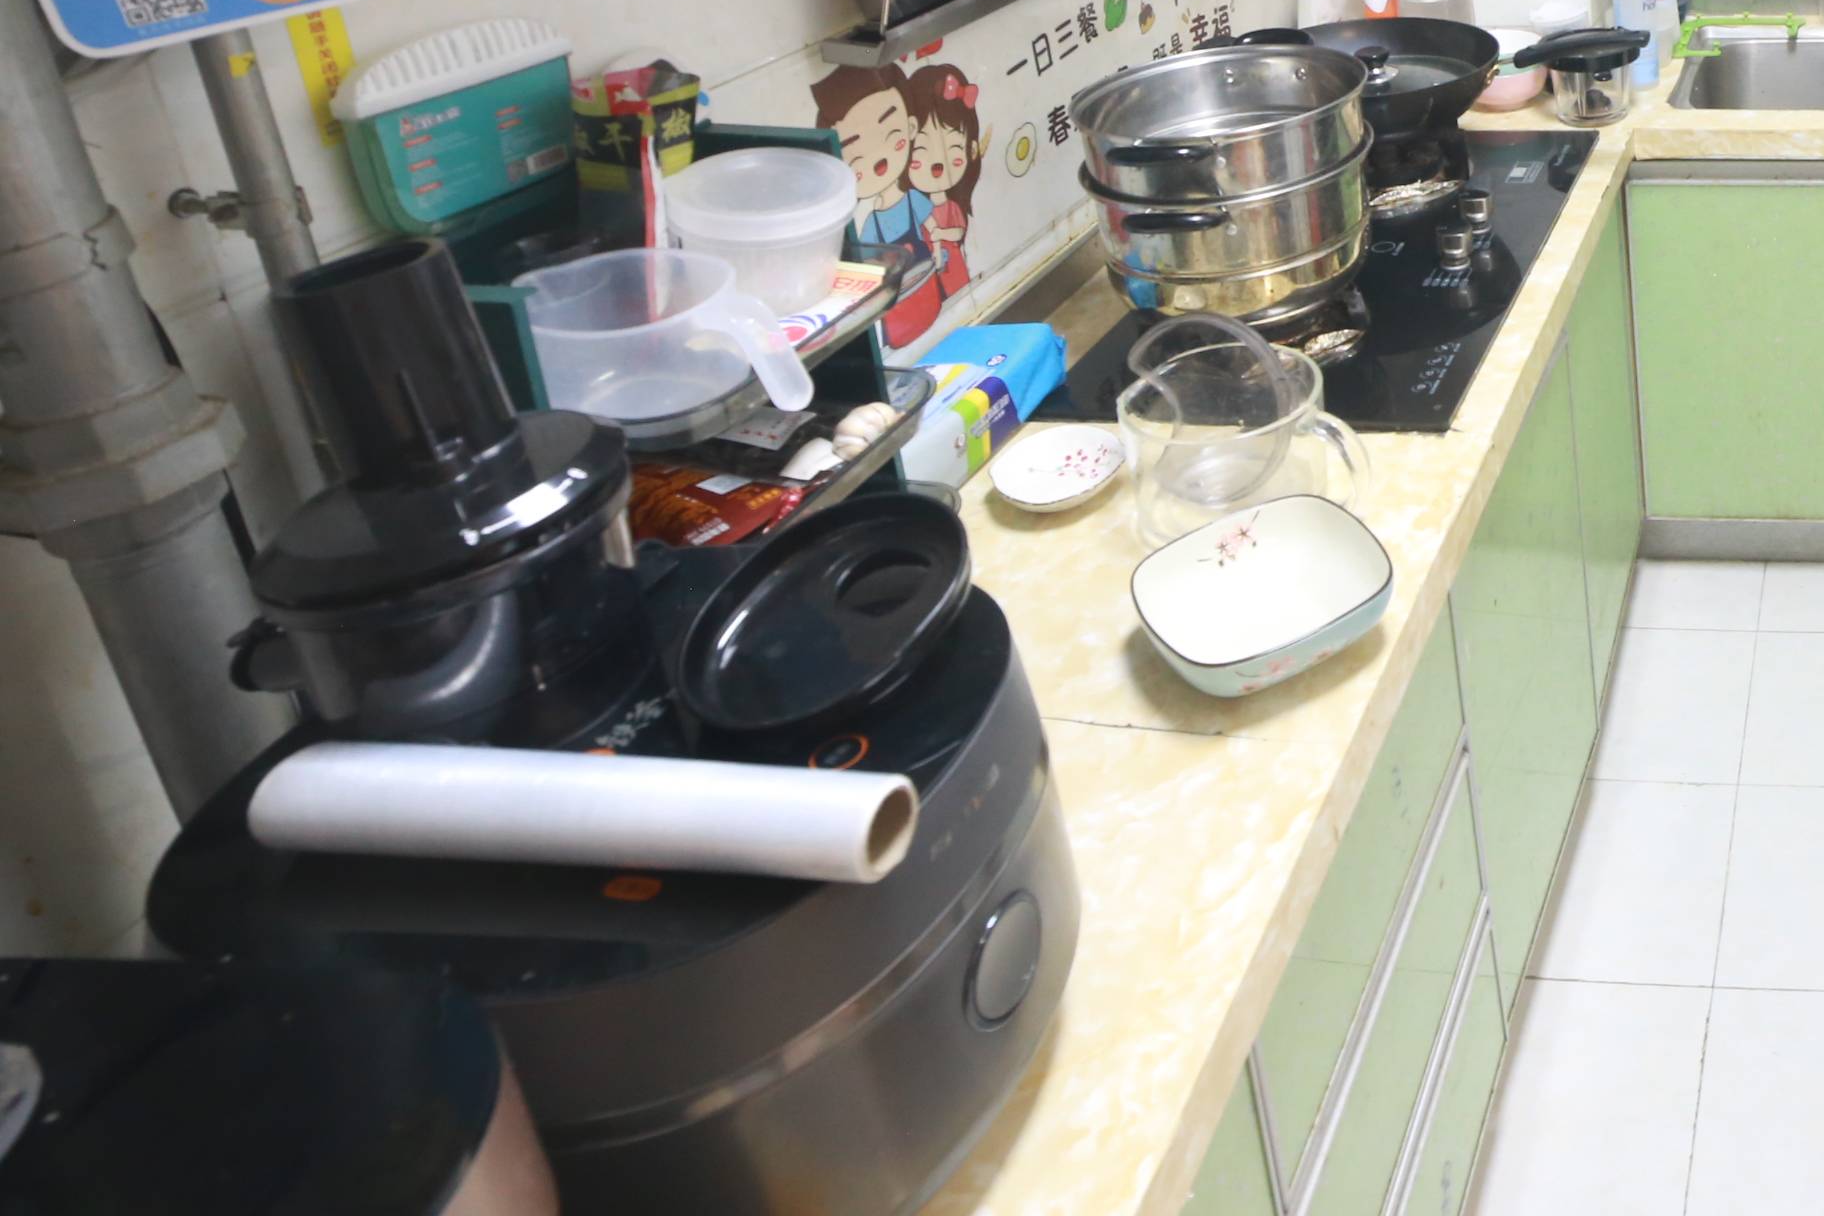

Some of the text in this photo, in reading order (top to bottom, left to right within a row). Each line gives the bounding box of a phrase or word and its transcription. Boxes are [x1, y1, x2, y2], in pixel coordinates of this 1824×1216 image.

[1006, 3, 1100, 77] 一日三餐
[1189, 3, 1233, 44] 幸福
